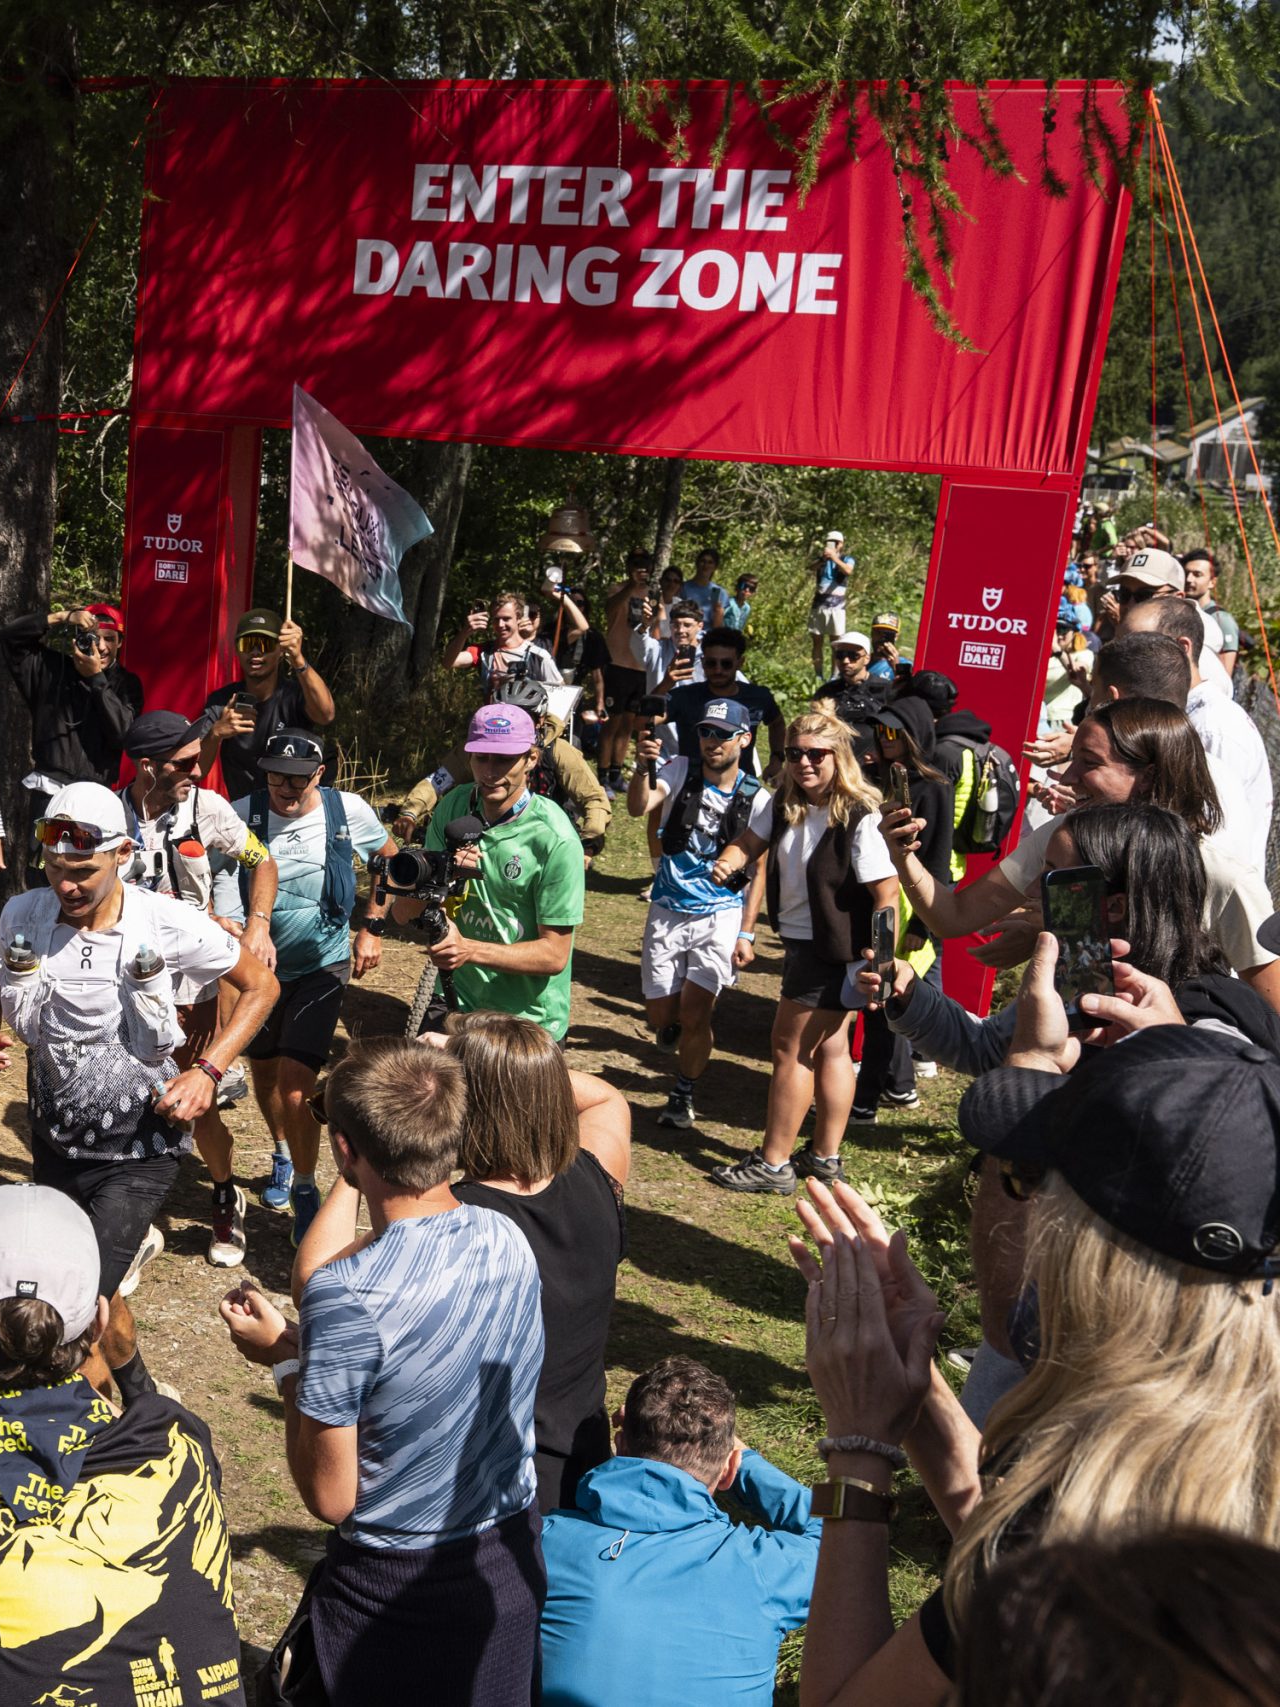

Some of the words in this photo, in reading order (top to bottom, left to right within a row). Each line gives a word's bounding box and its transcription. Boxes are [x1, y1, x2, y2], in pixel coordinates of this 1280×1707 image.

[411, 163, 633, 227] ENTER
[647, 167, 792, 231] THE
[353, 238, 621, 307] DARING
[632, 248, 843, 314] ZONE
[143, 535, 203, 553] TUDOR
[158, 562, 176, 570] BORN
[158, 569, 185, 580] DARE
[948, 612, 1027, 635] TUDOR
[965, 644, 988, 654] BORN
[990, 647, 1001, 655] TO
[963, 652, 1000, 667] DARE
[28, 1472, 64, 1500] The
[13, 1486, 54, 1514] Fee
[129, 1657, 153, 1670] ULTRA
[196, 1658, 239, 1685] KIPRUN
[134, 1680, 167, 1695] MASSIFS
